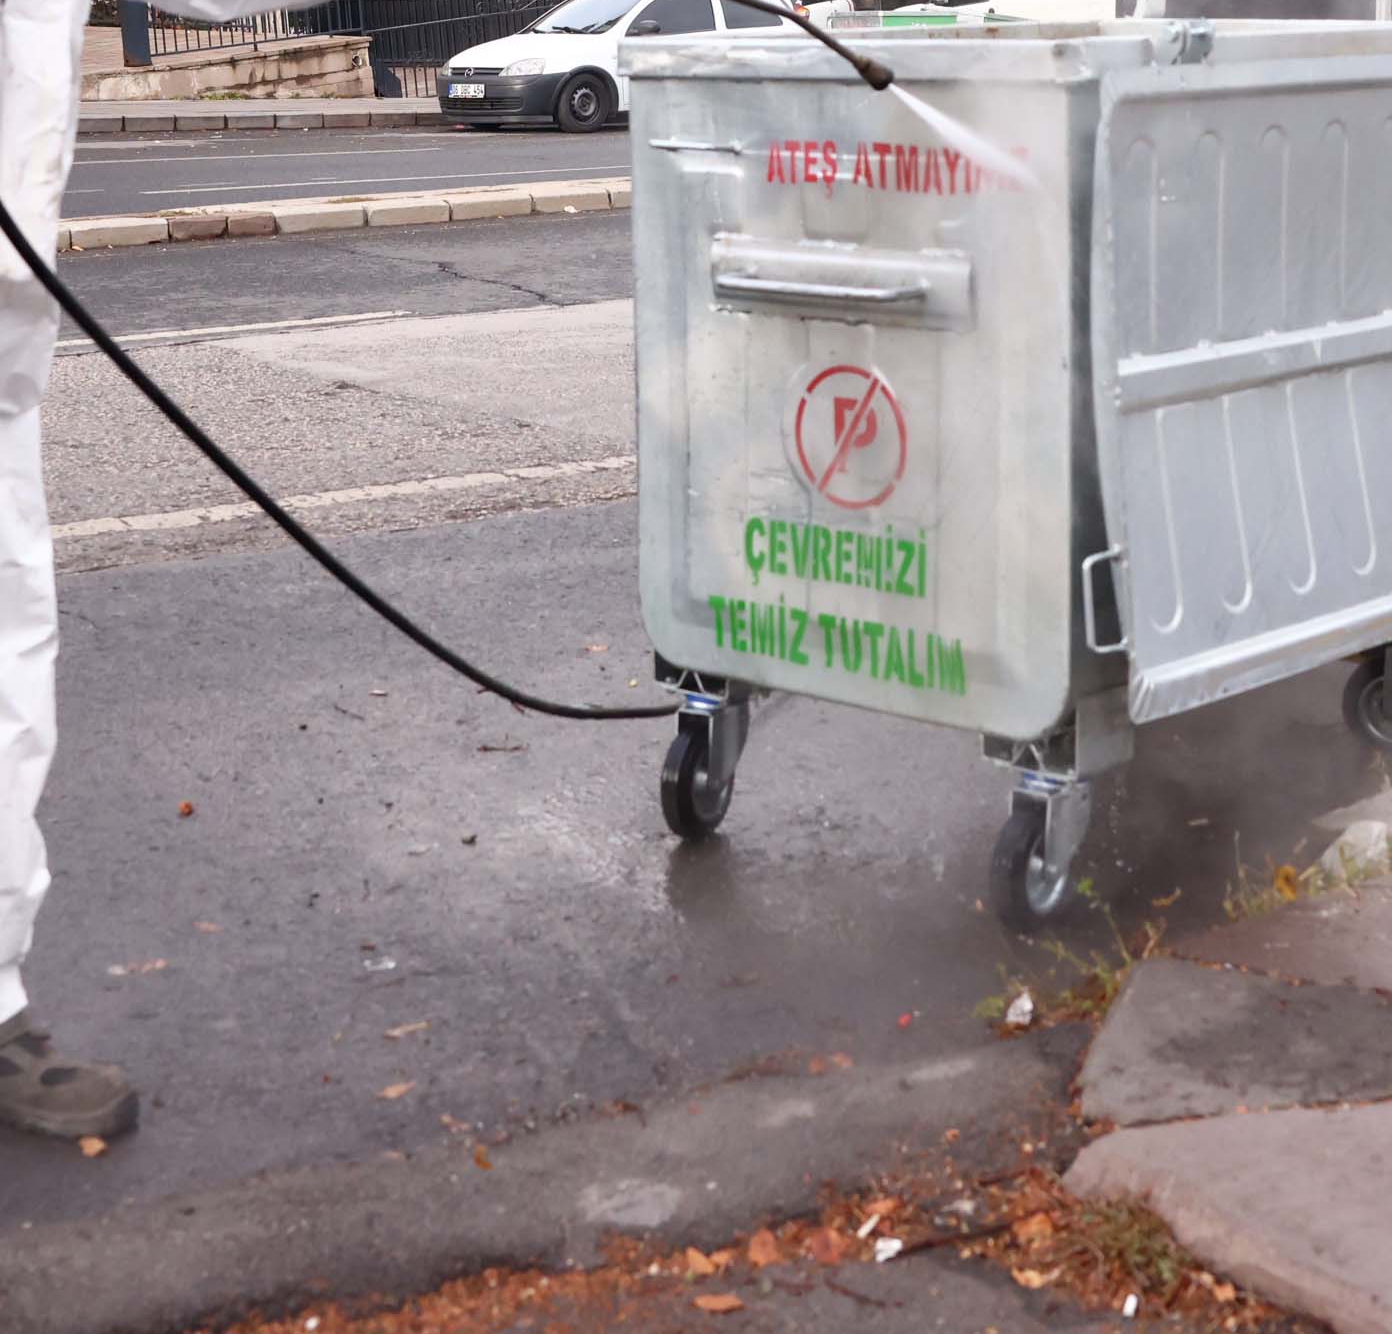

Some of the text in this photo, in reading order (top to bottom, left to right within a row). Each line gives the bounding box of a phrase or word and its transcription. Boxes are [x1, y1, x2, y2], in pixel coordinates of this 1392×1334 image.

[767, 139, 838, 199] ATEŞ
[745, 516, 927, 599] ÇEVREMİZİ
[708, 591, 967, 697] TEMİZ TUTALIM
